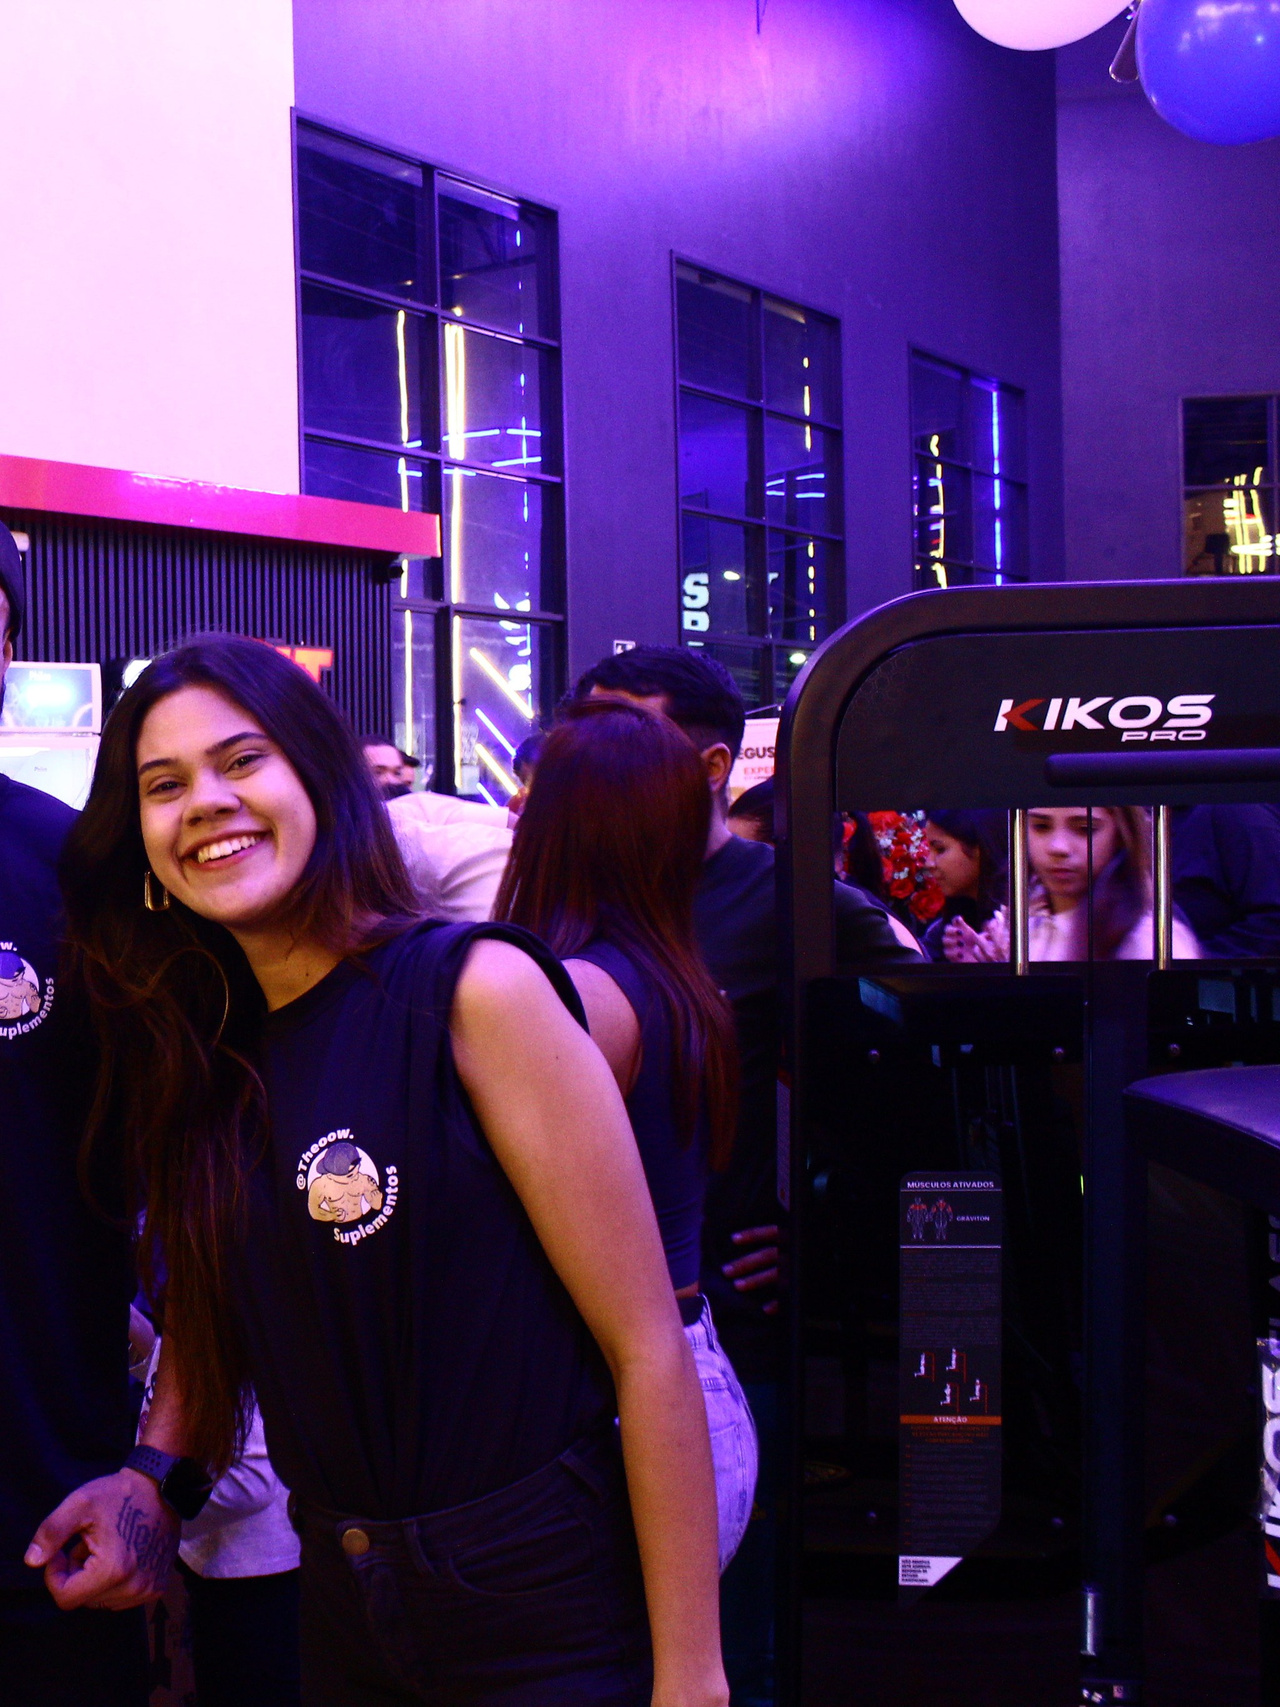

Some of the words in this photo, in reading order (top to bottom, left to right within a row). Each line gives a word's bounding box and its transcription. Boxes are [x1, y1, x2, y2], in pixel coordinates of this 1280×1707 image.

[994, 694, 1216, 732] KIKOS
[1121, 730, 1207, 742] PRO
[907, 1180, 951, 1188] MÚSCULOS
[333, 1165, 399, 1246] Suplementos
[933, 1415, 968, 1425] ATENÇÃO
